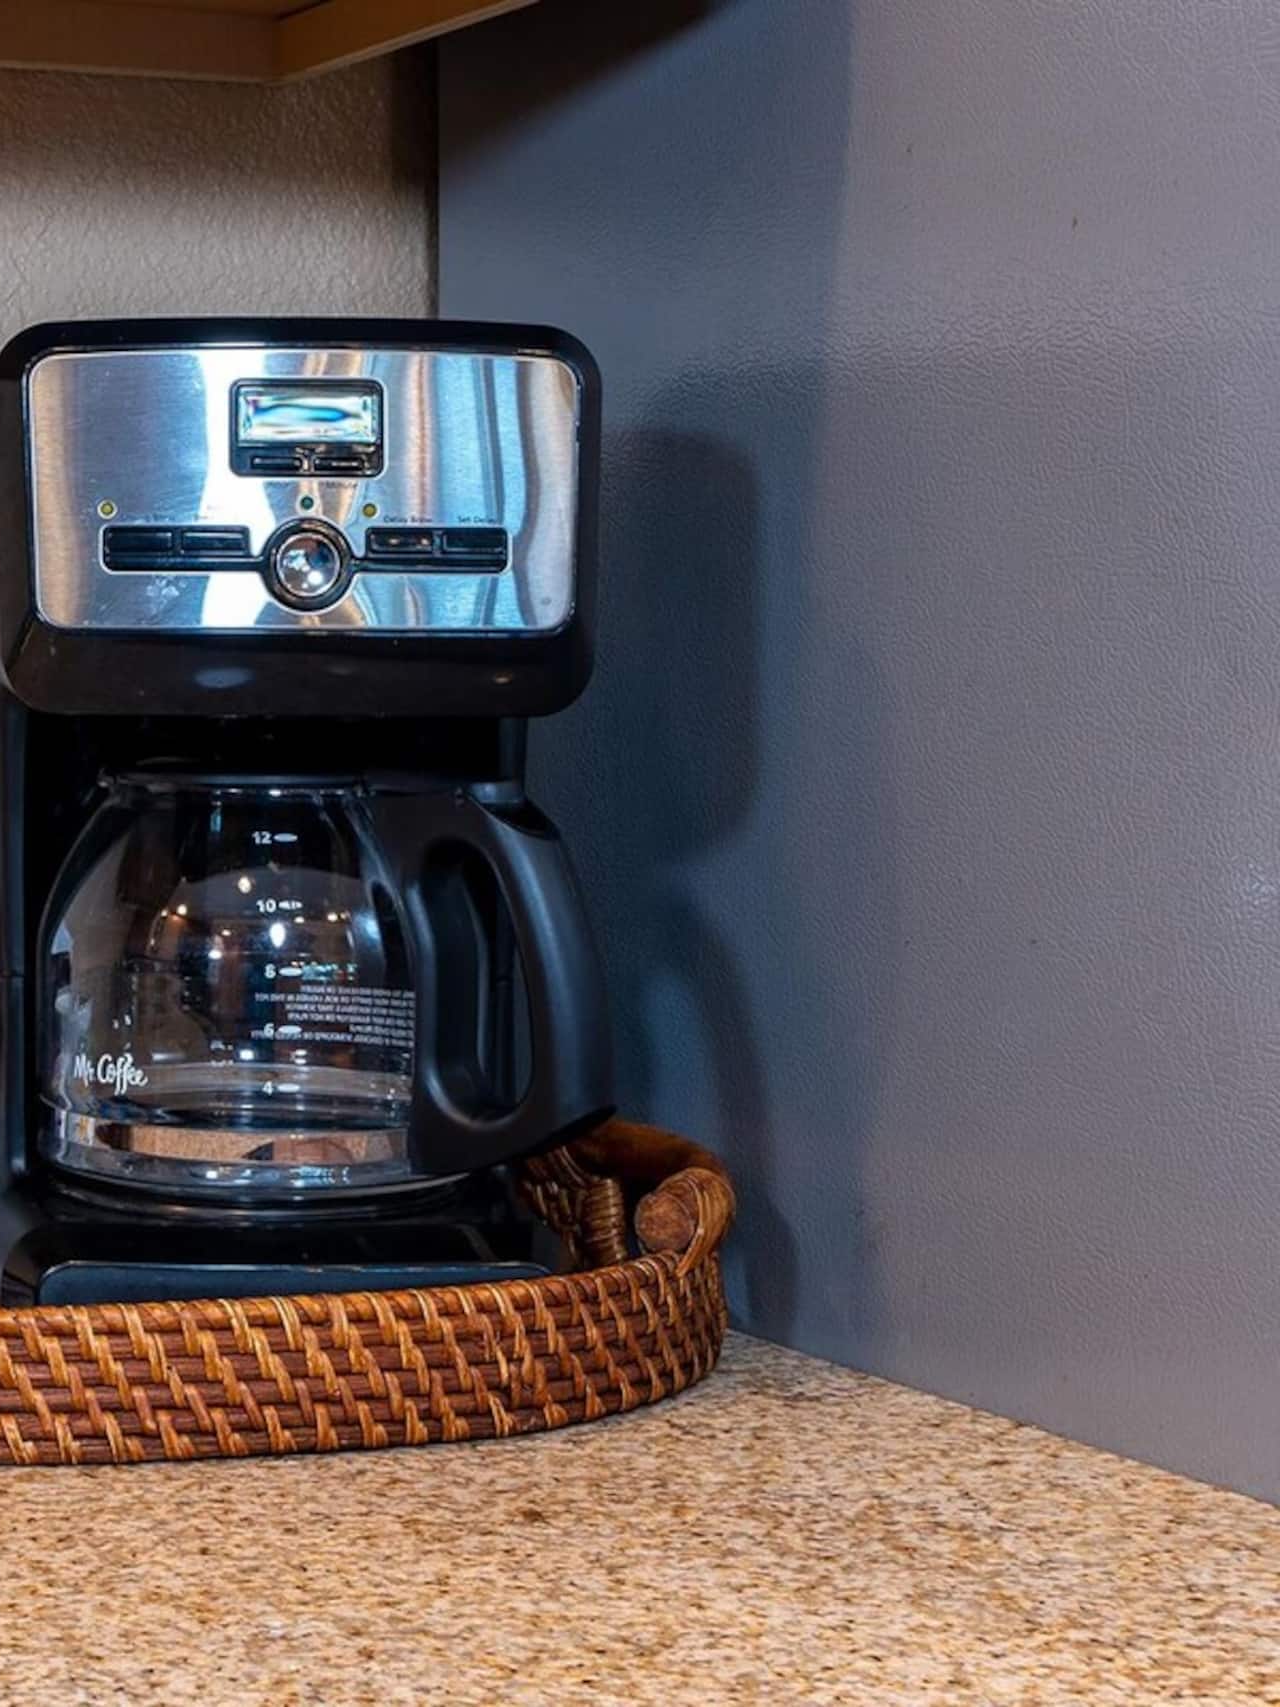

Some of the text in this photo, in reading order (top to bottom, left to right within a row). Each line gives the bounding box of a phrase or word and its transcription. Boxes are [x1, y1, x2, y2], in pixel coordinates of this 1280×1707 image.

[251, 831, 272, 845] 12
[256, 900, 277, 913] 10
[264, 963, 276, 979] 8
[263, 1023, 275, 1037] 6
[97, 1053, 148, 1096] Coffee
[262, 1081, 274, 1095] 4
